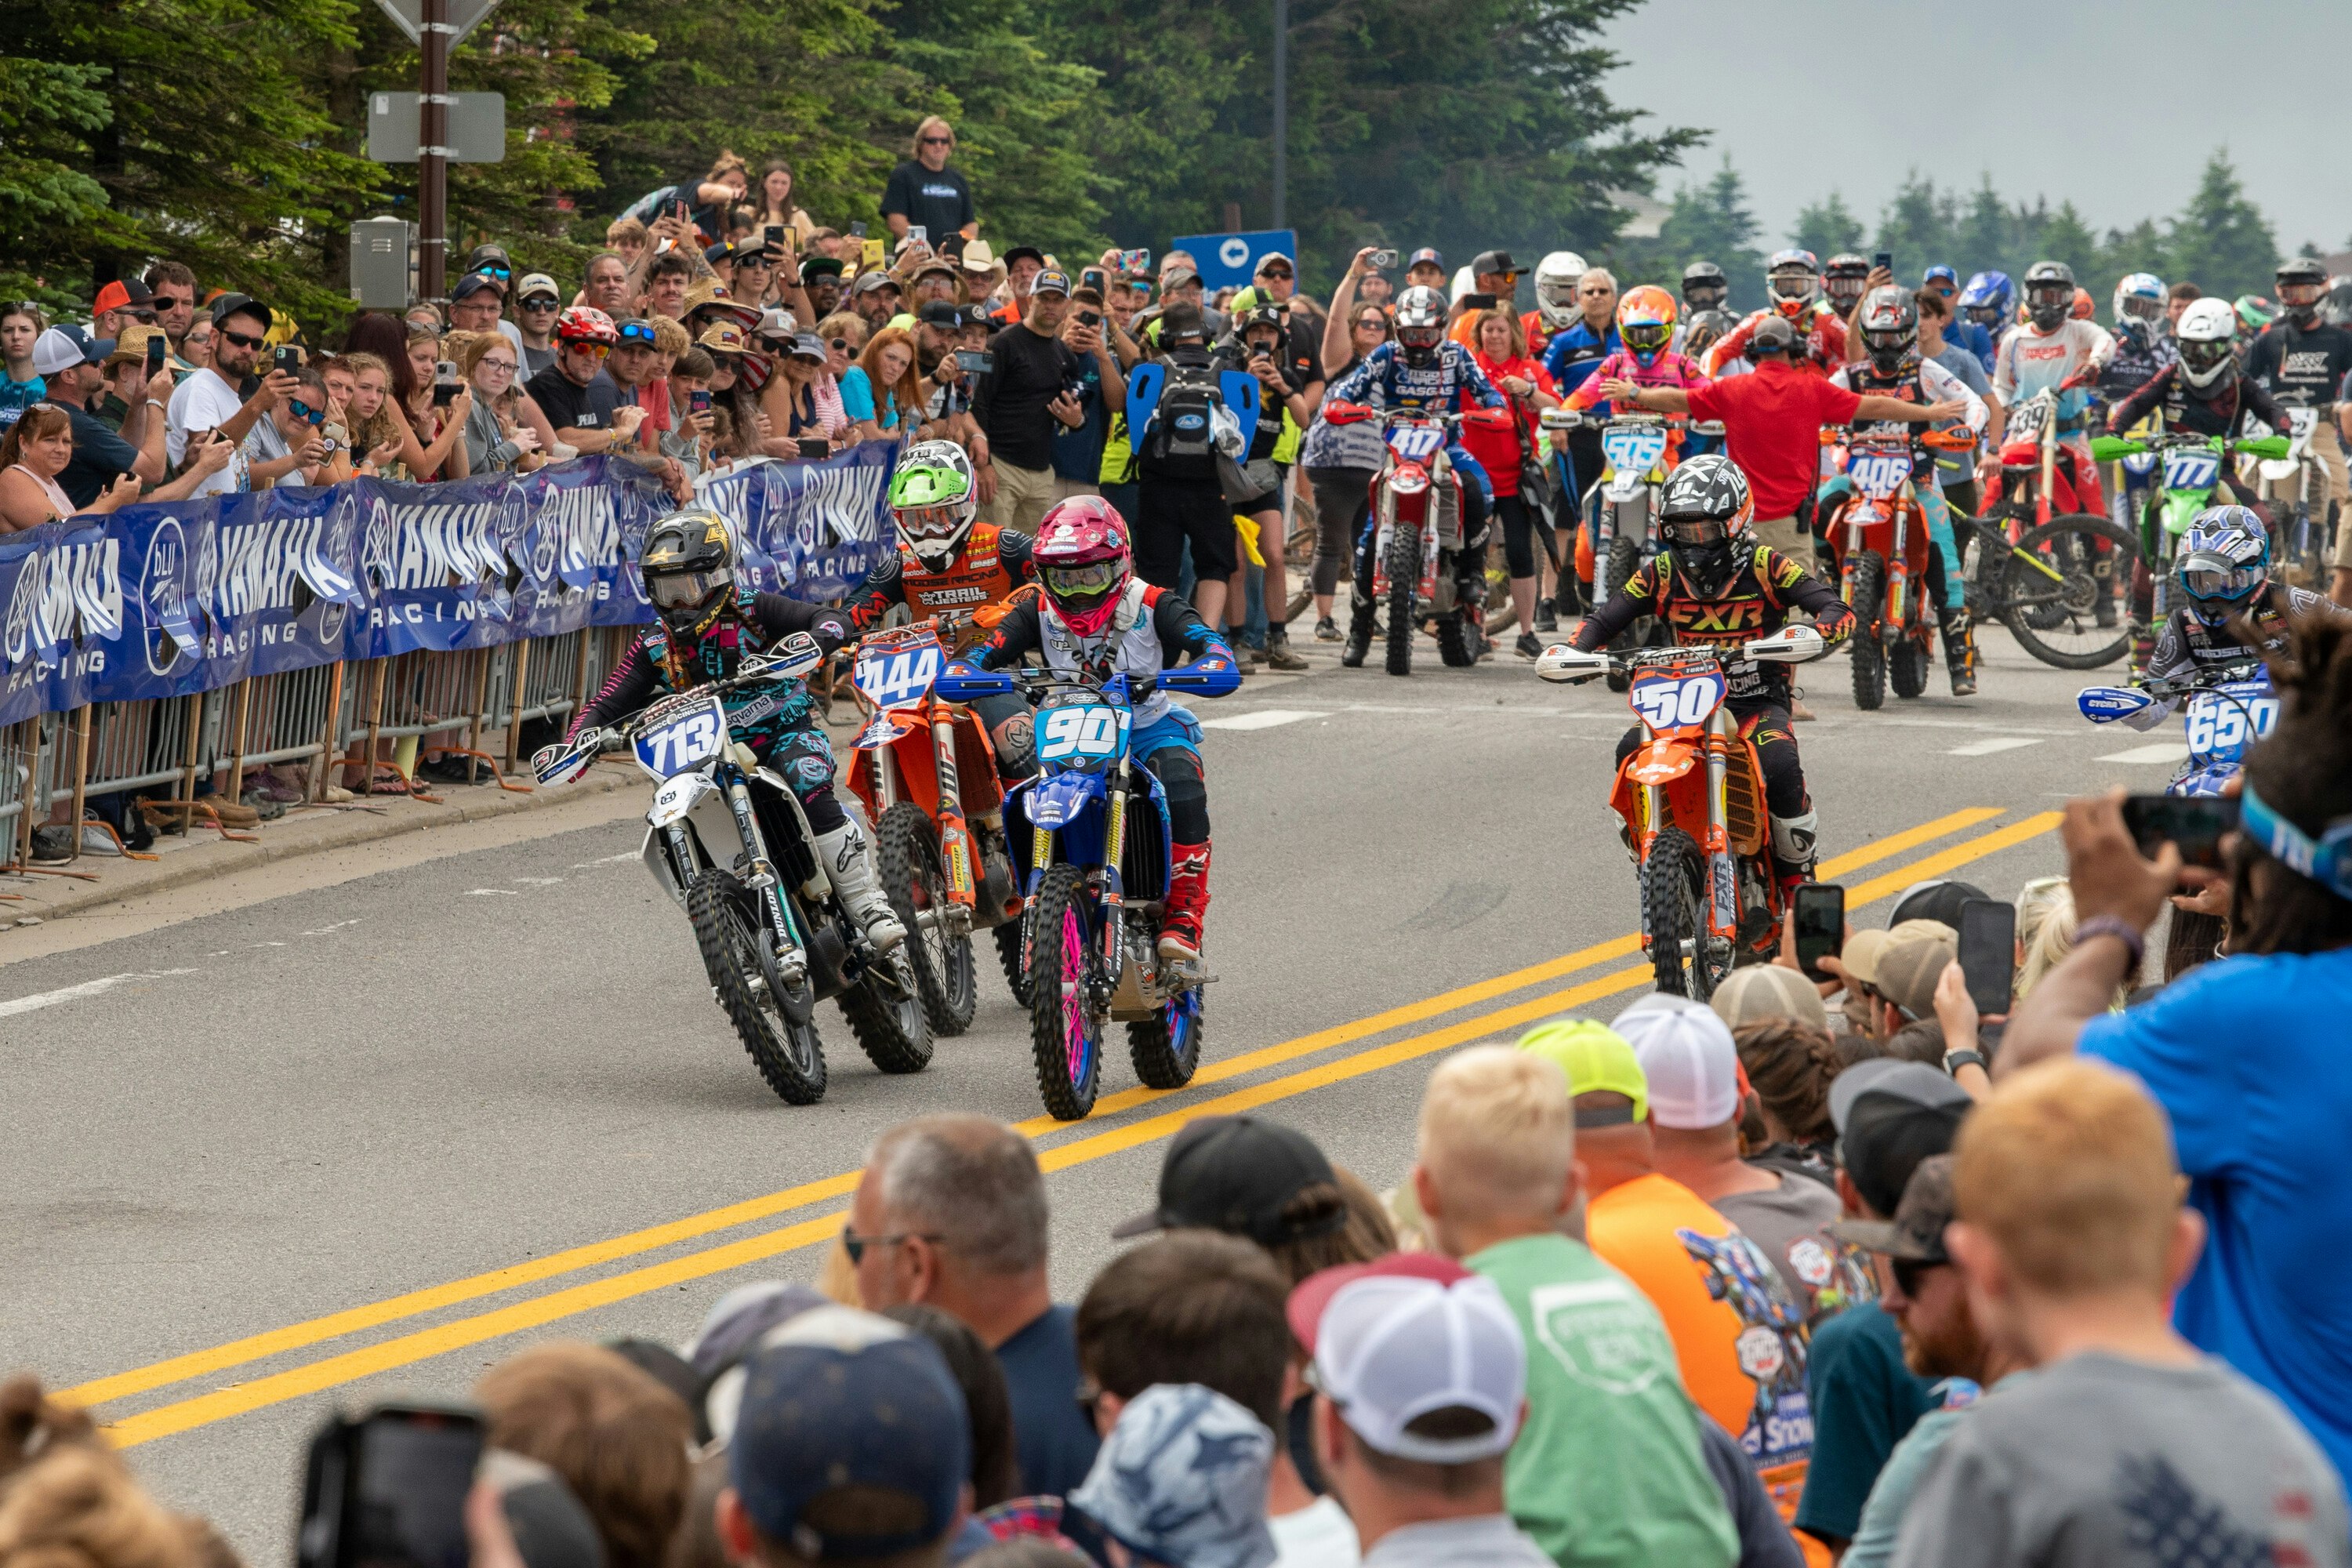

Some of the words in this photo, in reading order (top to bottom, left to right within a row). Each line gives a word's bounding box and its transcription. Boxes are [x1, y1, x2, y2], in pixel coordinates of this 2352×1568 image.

[1396, 386, 1454, 396] GASGAS
[1389, 428, 1443, 456] 417
[1607, 436, 1662, 469] 505
[1850, 458, 1908, 492] 406
[2166, 458, 2217, 489] 777
[951, 568, 1000, 585] RACING
[535, 581, 610, 609] RACING
[934, 586, 986, 600] TRAIL
[935, 593, 987, 605] JESTERS
[371, 600, 488, 629] RACING
[929, 608, 974, 625] KT
[207, 622, 298, 659] RACING
[7, 650, 105, 694] RACING
[744, 660, 759, 670] 713
[862, 648, 938, 709] 444
[1686, 664, 1714, 673] TURNR
[1637, 689, 1642, 702] 1
[1726, 672, 1761, 693] ACING
[1642, 677, 1718, 730] 50
[583, 731, 597, 744] 713
[1040, 706, 1116, 758] 90
[2187, 698, 2280, 754] 650
[647, 713, 715, 774] 713
[1036, 815, 1063, 824] YAMAHA
[953, 847, 961, 883] DUNLOP
[960, 832, 970, 875] MOTOREX
[764, 887, 788, 938] DUNLOP
